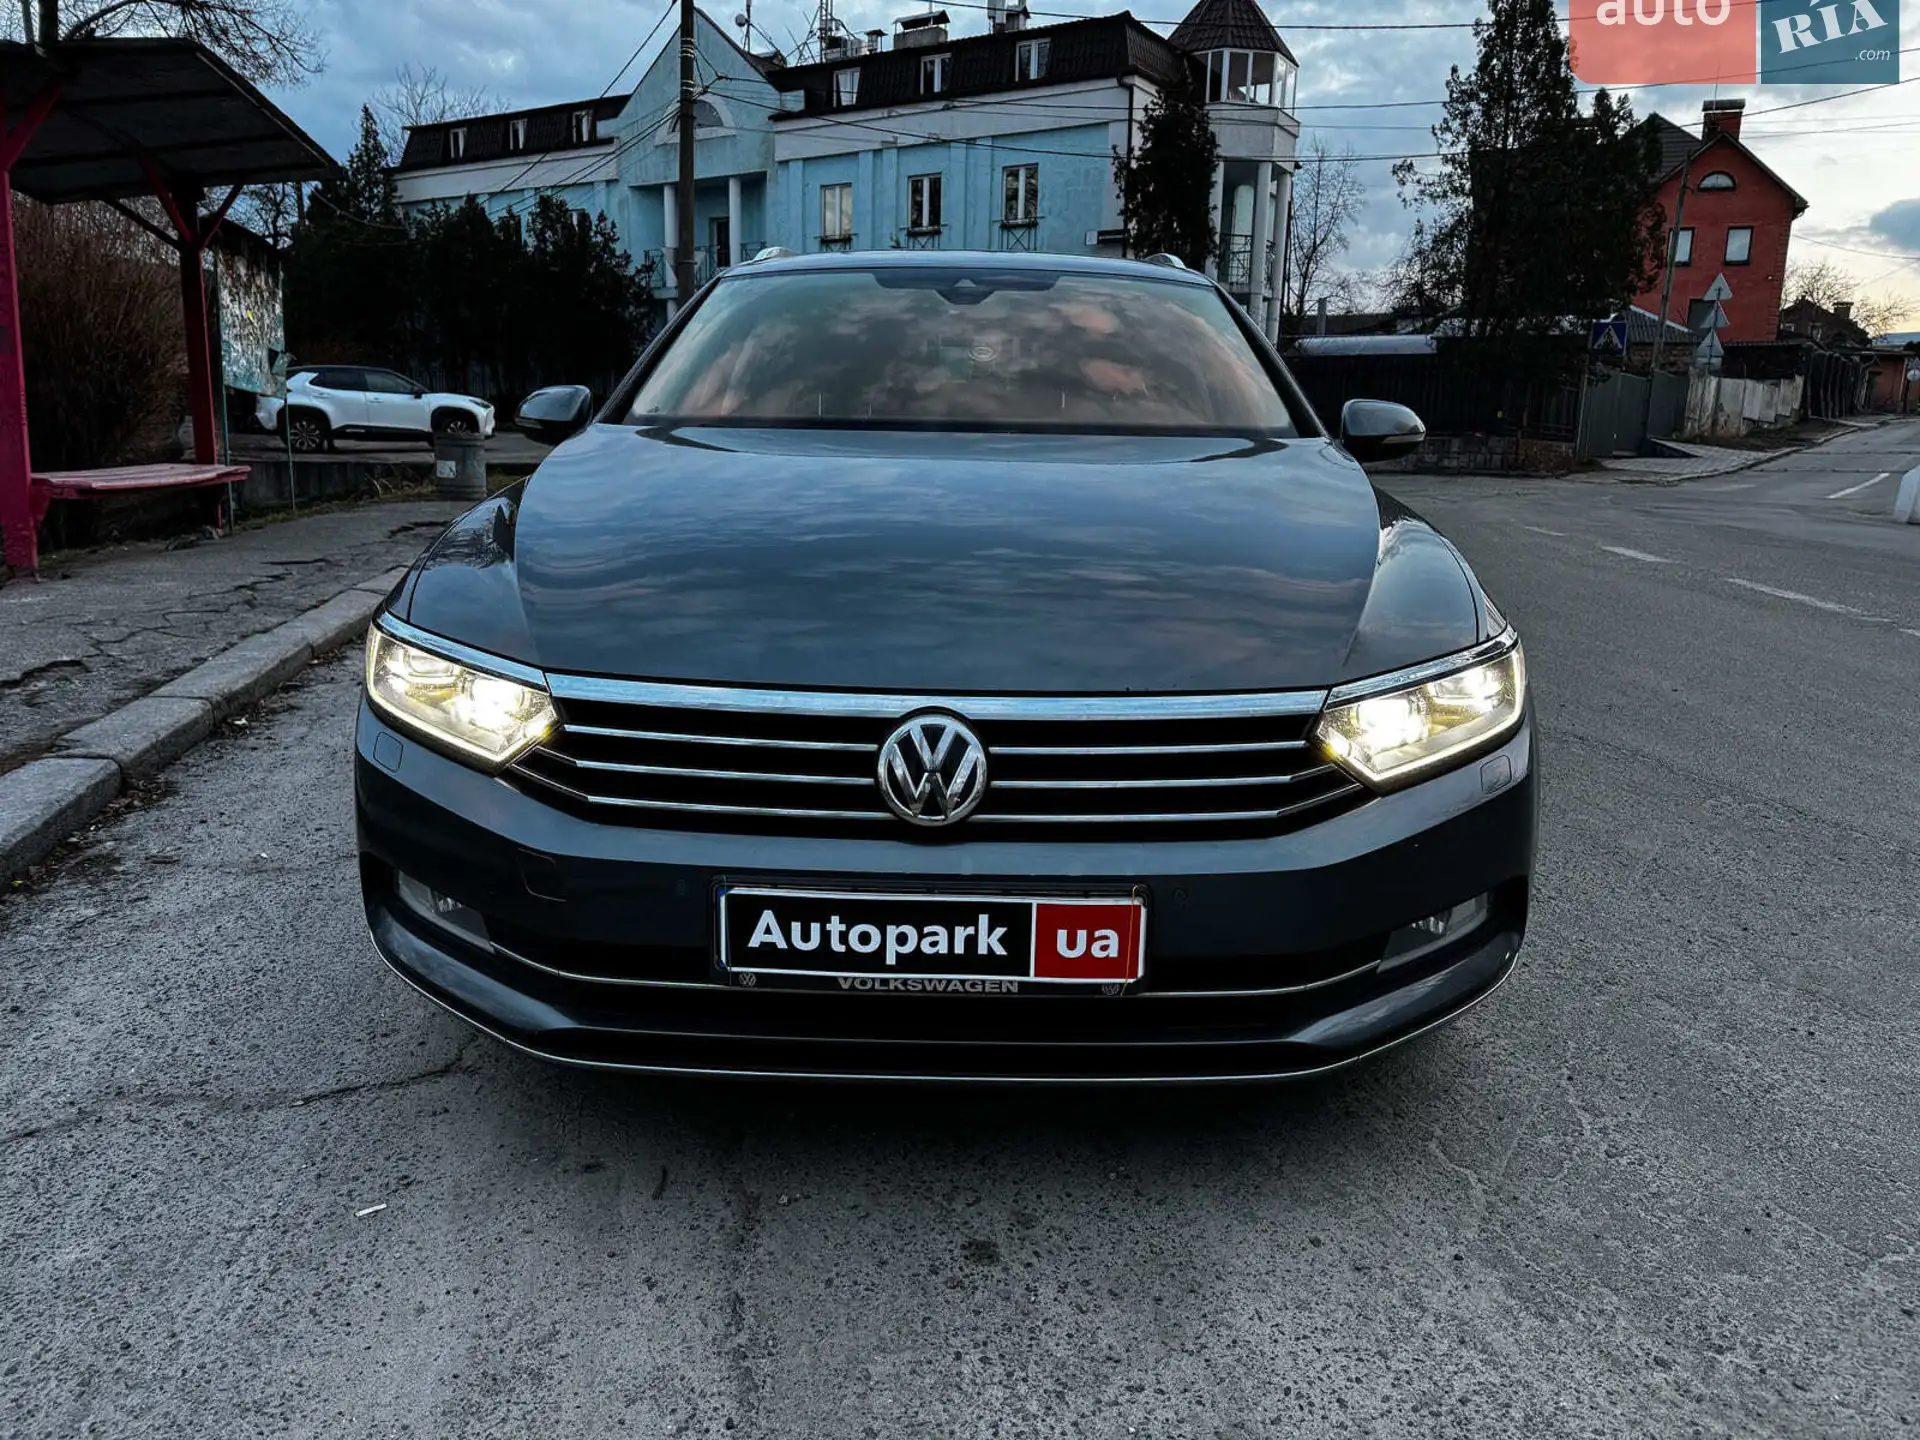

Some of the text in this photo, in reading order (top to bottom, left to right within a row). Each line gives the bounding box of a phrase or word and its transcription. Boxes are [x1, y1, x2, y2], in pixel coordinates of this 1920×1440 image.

[747, 909, 1009, 966] Autopark
[1056, 928, 1120, 958] ua
[837, 976, 1019, 993] VOLKSWAGEN
